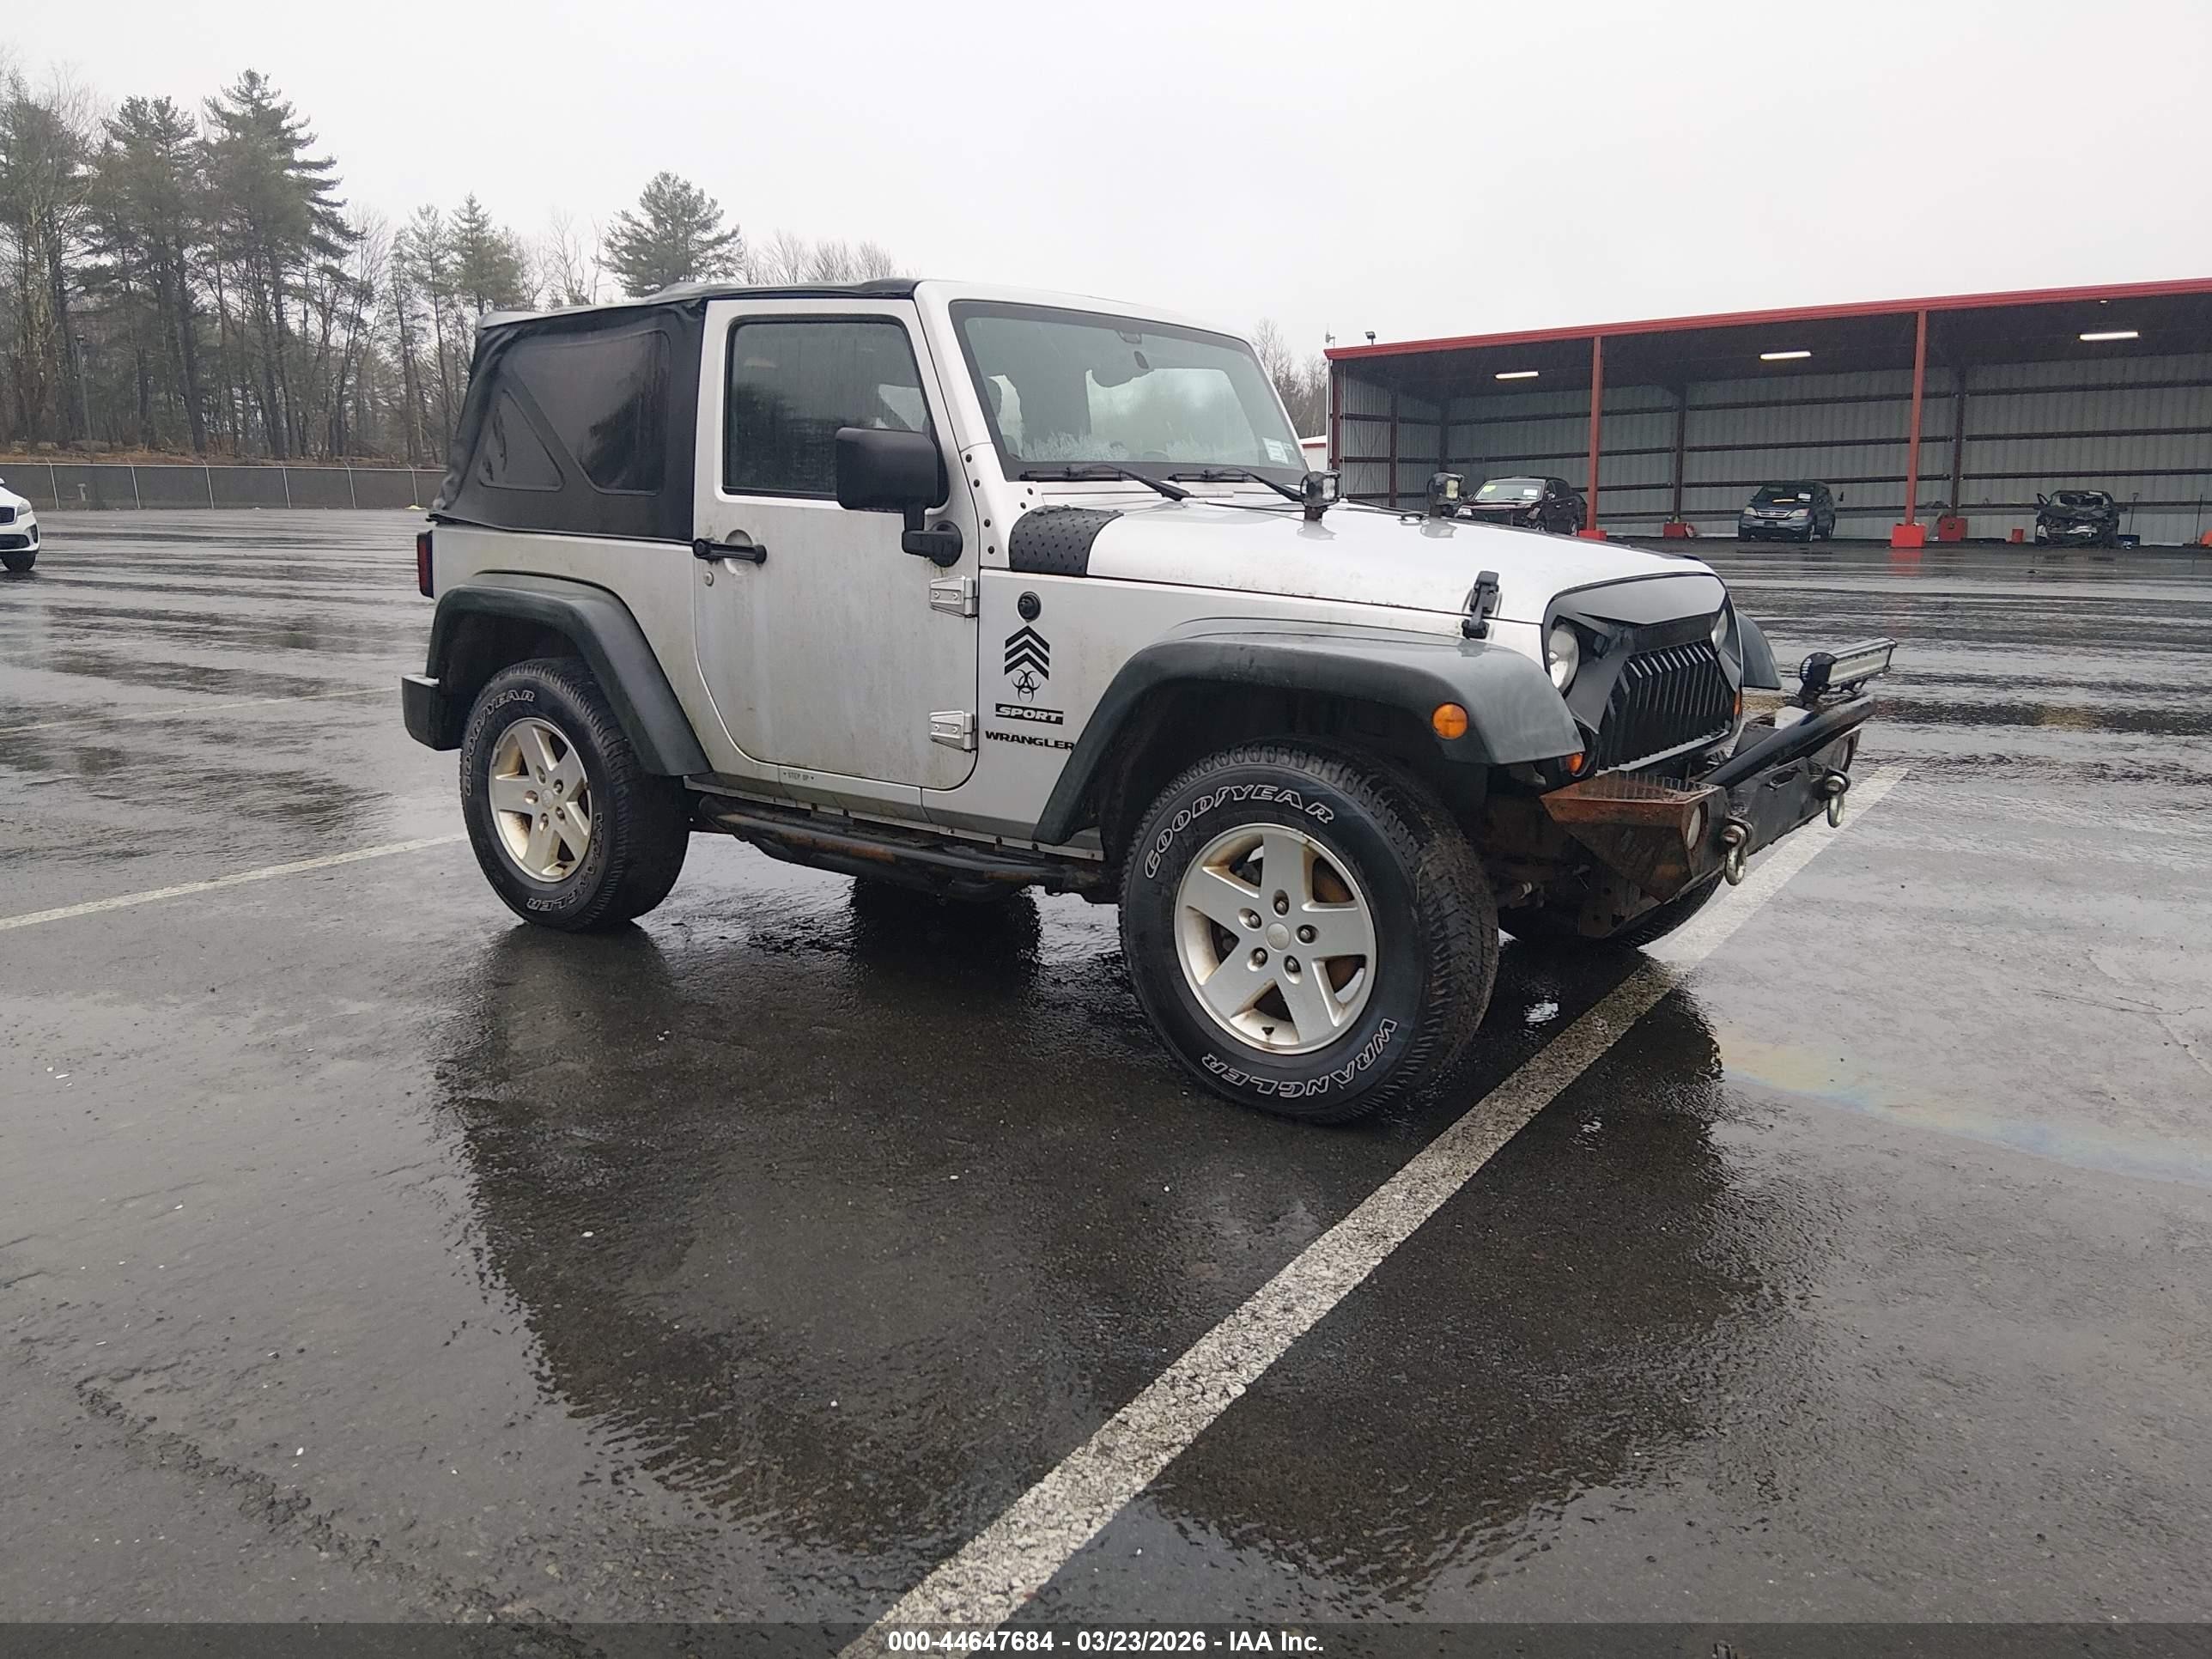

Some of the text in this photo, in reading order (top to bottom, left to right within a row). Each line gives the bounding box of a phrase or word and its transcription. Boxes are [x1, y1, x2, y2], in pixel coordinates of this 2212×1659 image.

[996, 706, 1063, 722] SPORT
[985, 730, 1075, 750] WRANGLER
[1144, 784, 1335, 879] GOODYEAR
[1201, 1018, 1398, 1099] WRANGLER
